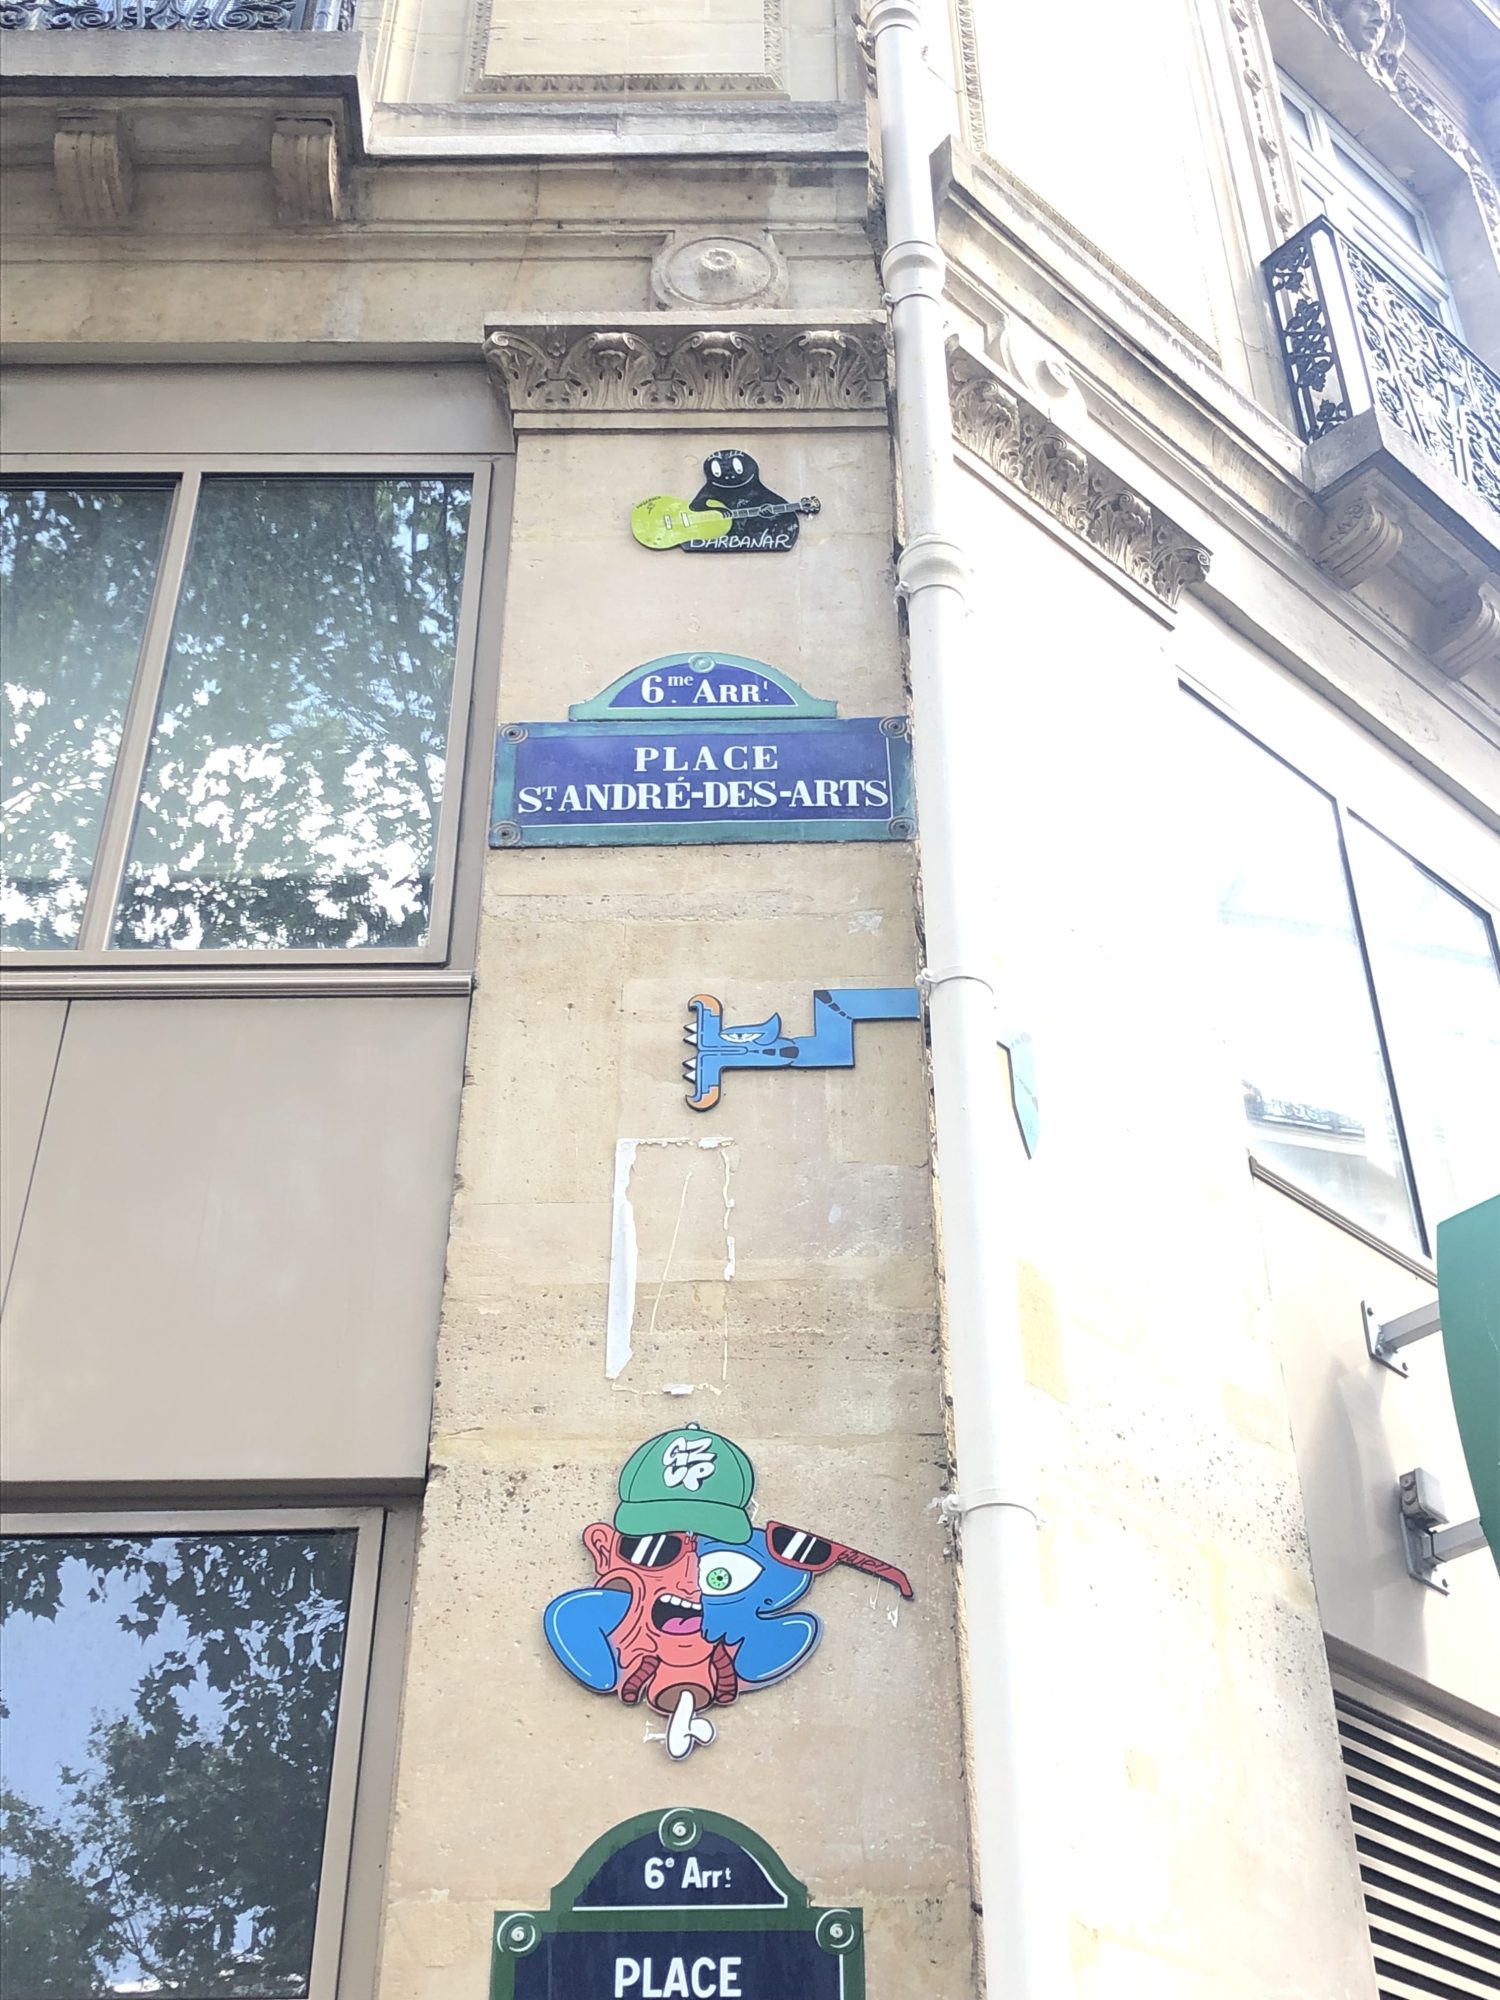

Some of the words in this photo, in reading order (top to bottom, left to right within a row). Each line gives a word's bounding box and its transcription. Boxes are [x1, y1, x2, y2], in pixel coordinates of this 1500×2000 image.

[633, 745, 779, 774] PLACE
[559, 777, 889, 813] ANDRÉ-DES-ARTS
[614, 1956, 742, 1999] PLACE
